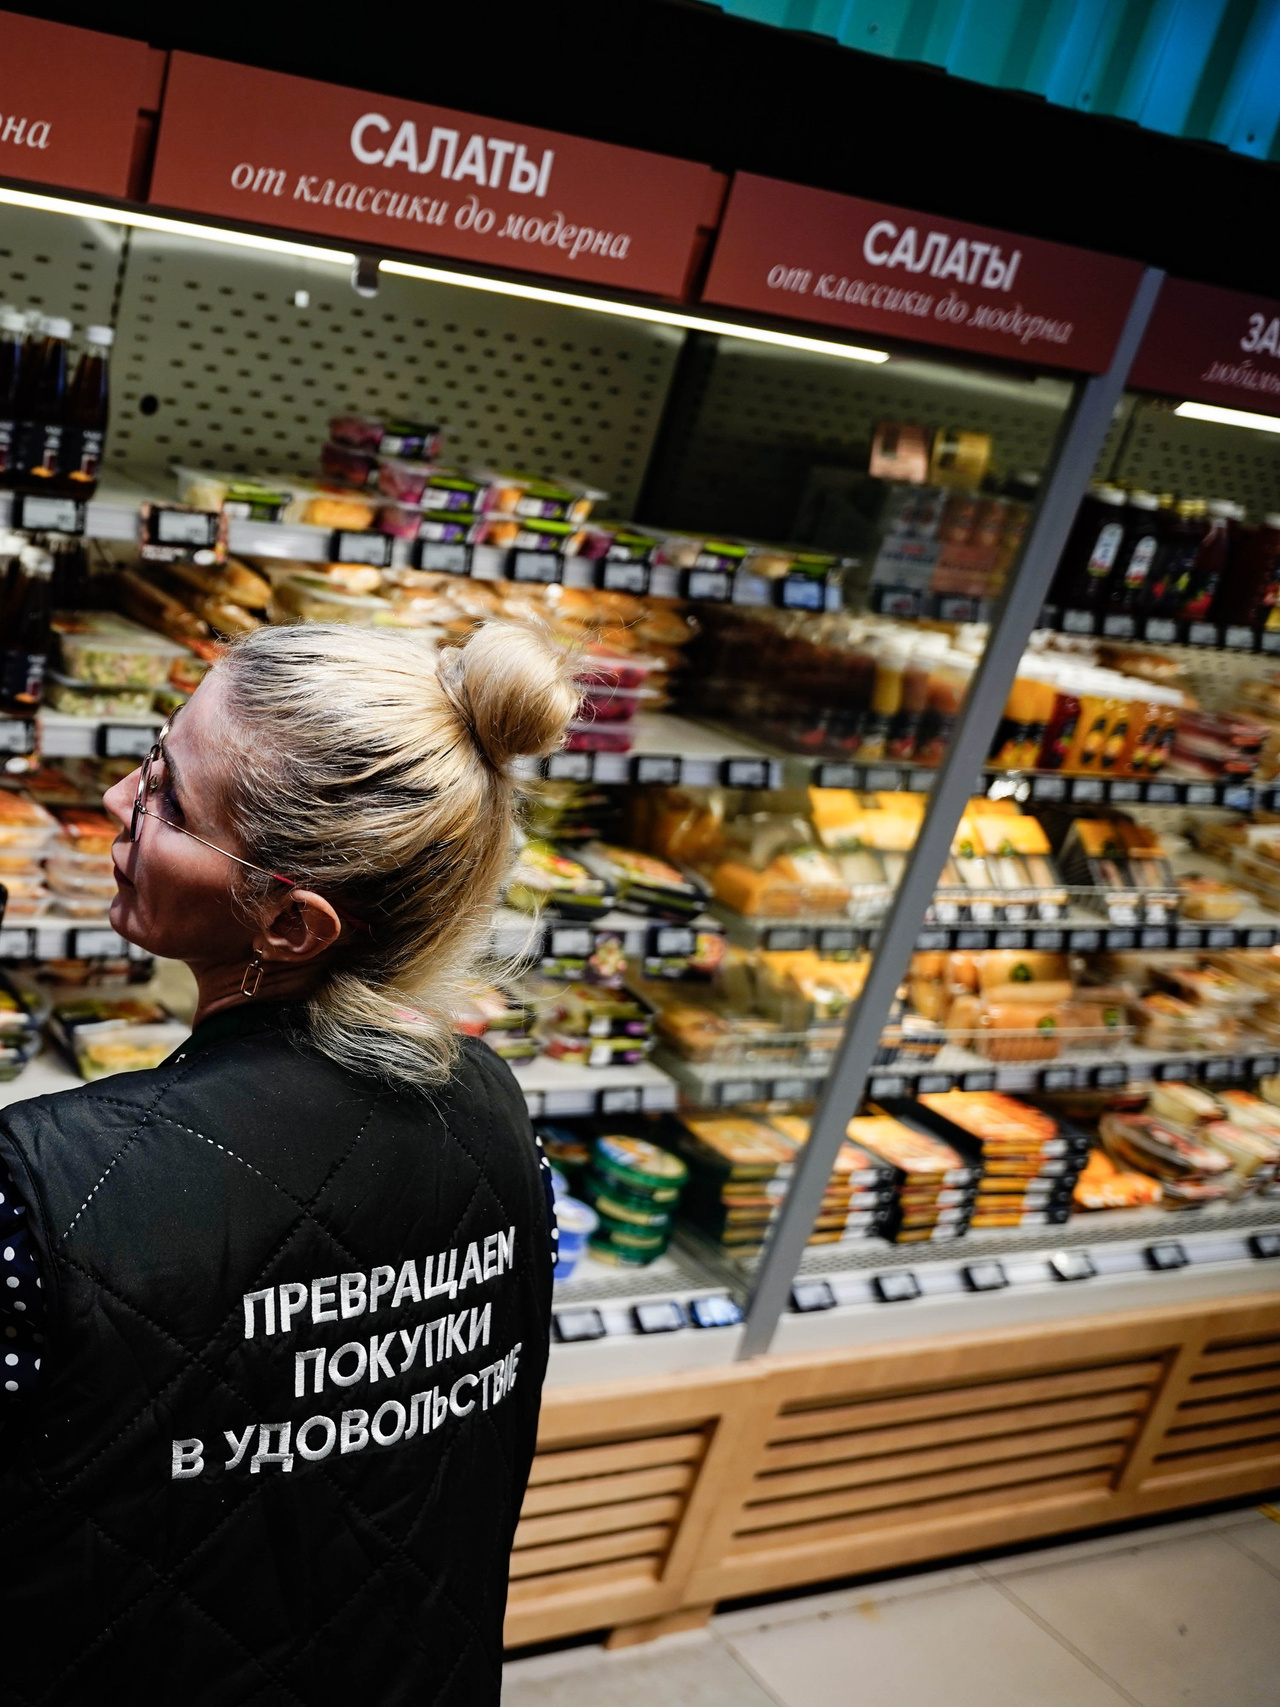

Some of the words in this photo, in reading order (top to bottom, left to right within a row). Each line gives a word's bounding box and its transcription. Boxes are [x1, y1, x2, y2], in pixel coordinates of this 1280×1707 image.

[349, 112, 556, 198] САЛАТЫ
[230, 162, 287, 197] от
[292, 174, 450, 227] классики
[453, 194, 497, 235] до
[496, 210, 632, 261] модерна
[862, 219, 1022, 293] САЛАТЫ
[766, 263, 813, 295] от
[813, 273, 935, 318] классики
[934, 289, 970, 324] до
[966, 302, 1074, 346] модерна
[1240, 311, 1280, 359] ЗА
[243, 1225, 516, 1340] ПРЕВРАЩАЕМ
[294, 1302, 492, 1398] ПОКУПКИ
[171, 1437, 205, 1480] В
[223, 1342, 523, 1474] УДОВОЛЬСТВИЕ
